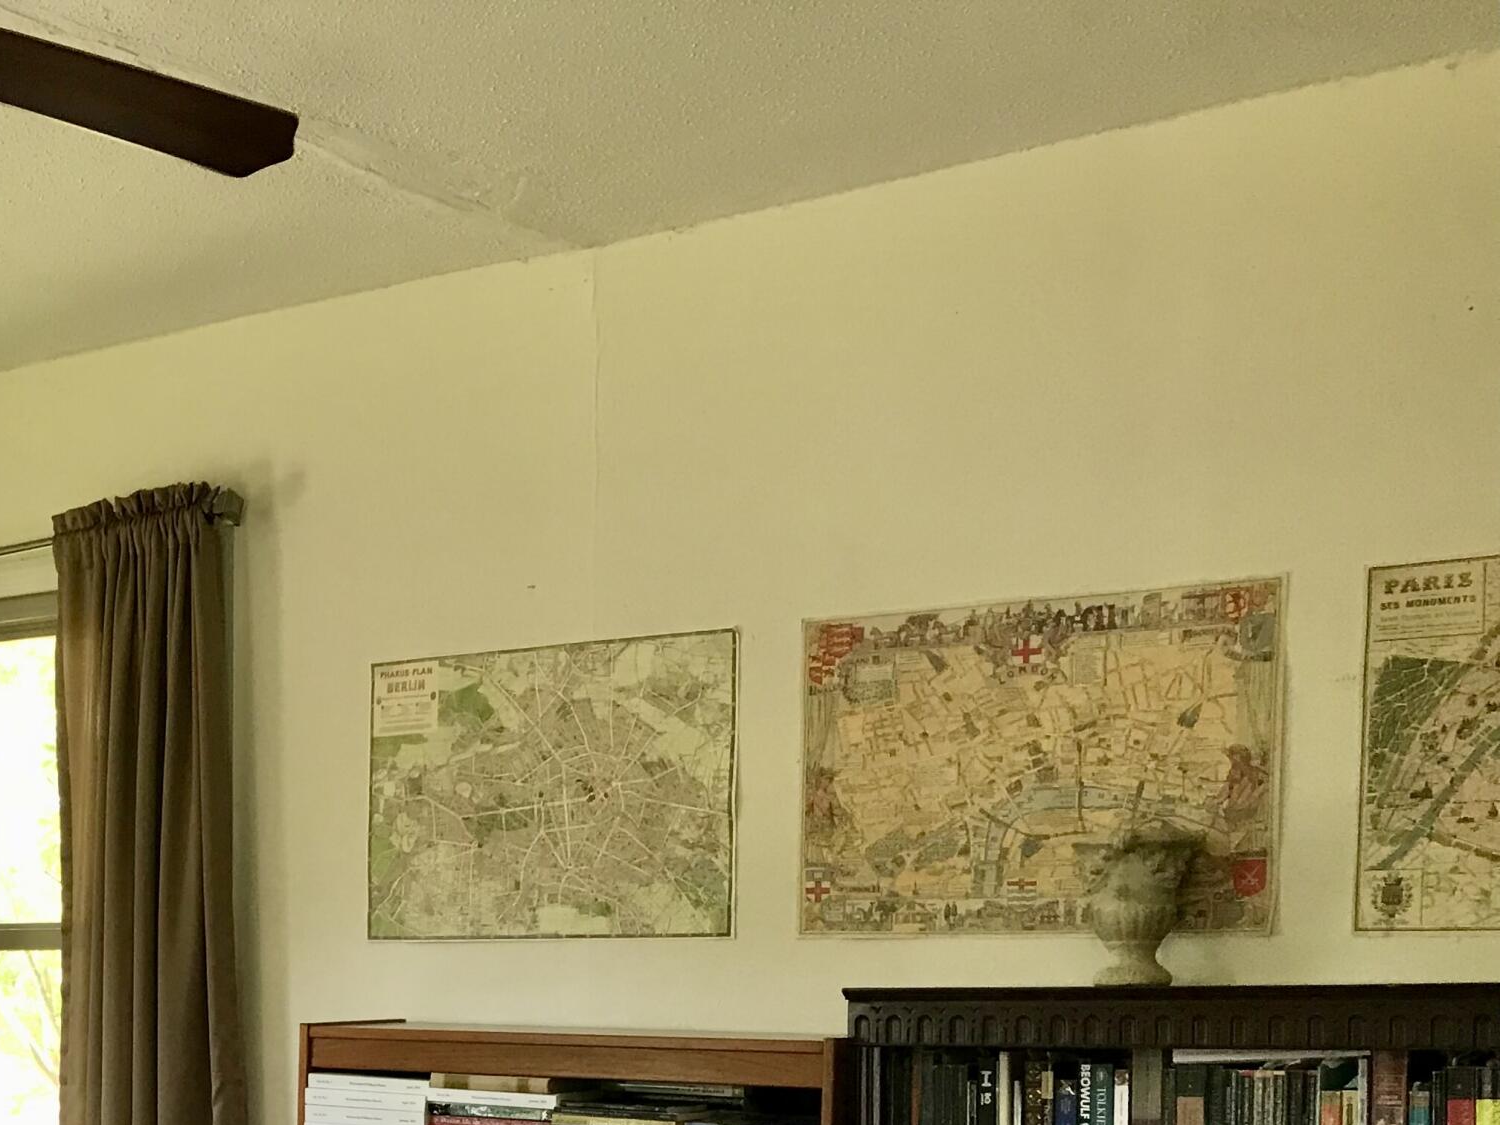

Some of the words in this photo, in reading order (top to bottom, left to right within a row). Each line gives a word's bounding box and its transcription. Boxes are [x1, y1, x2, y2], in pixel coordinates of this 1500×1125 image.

[1384, 573, 1473, 594] PARIS
[1380, 601, 1401, 611] SES
[1405, 595, 1477, 608] MONUMENTS
[998, 666, 1057, 685] LONDON
[387, 679, 426, 694] BERLIN
[1079, 1064, 1091, 1120] BEOWULF
